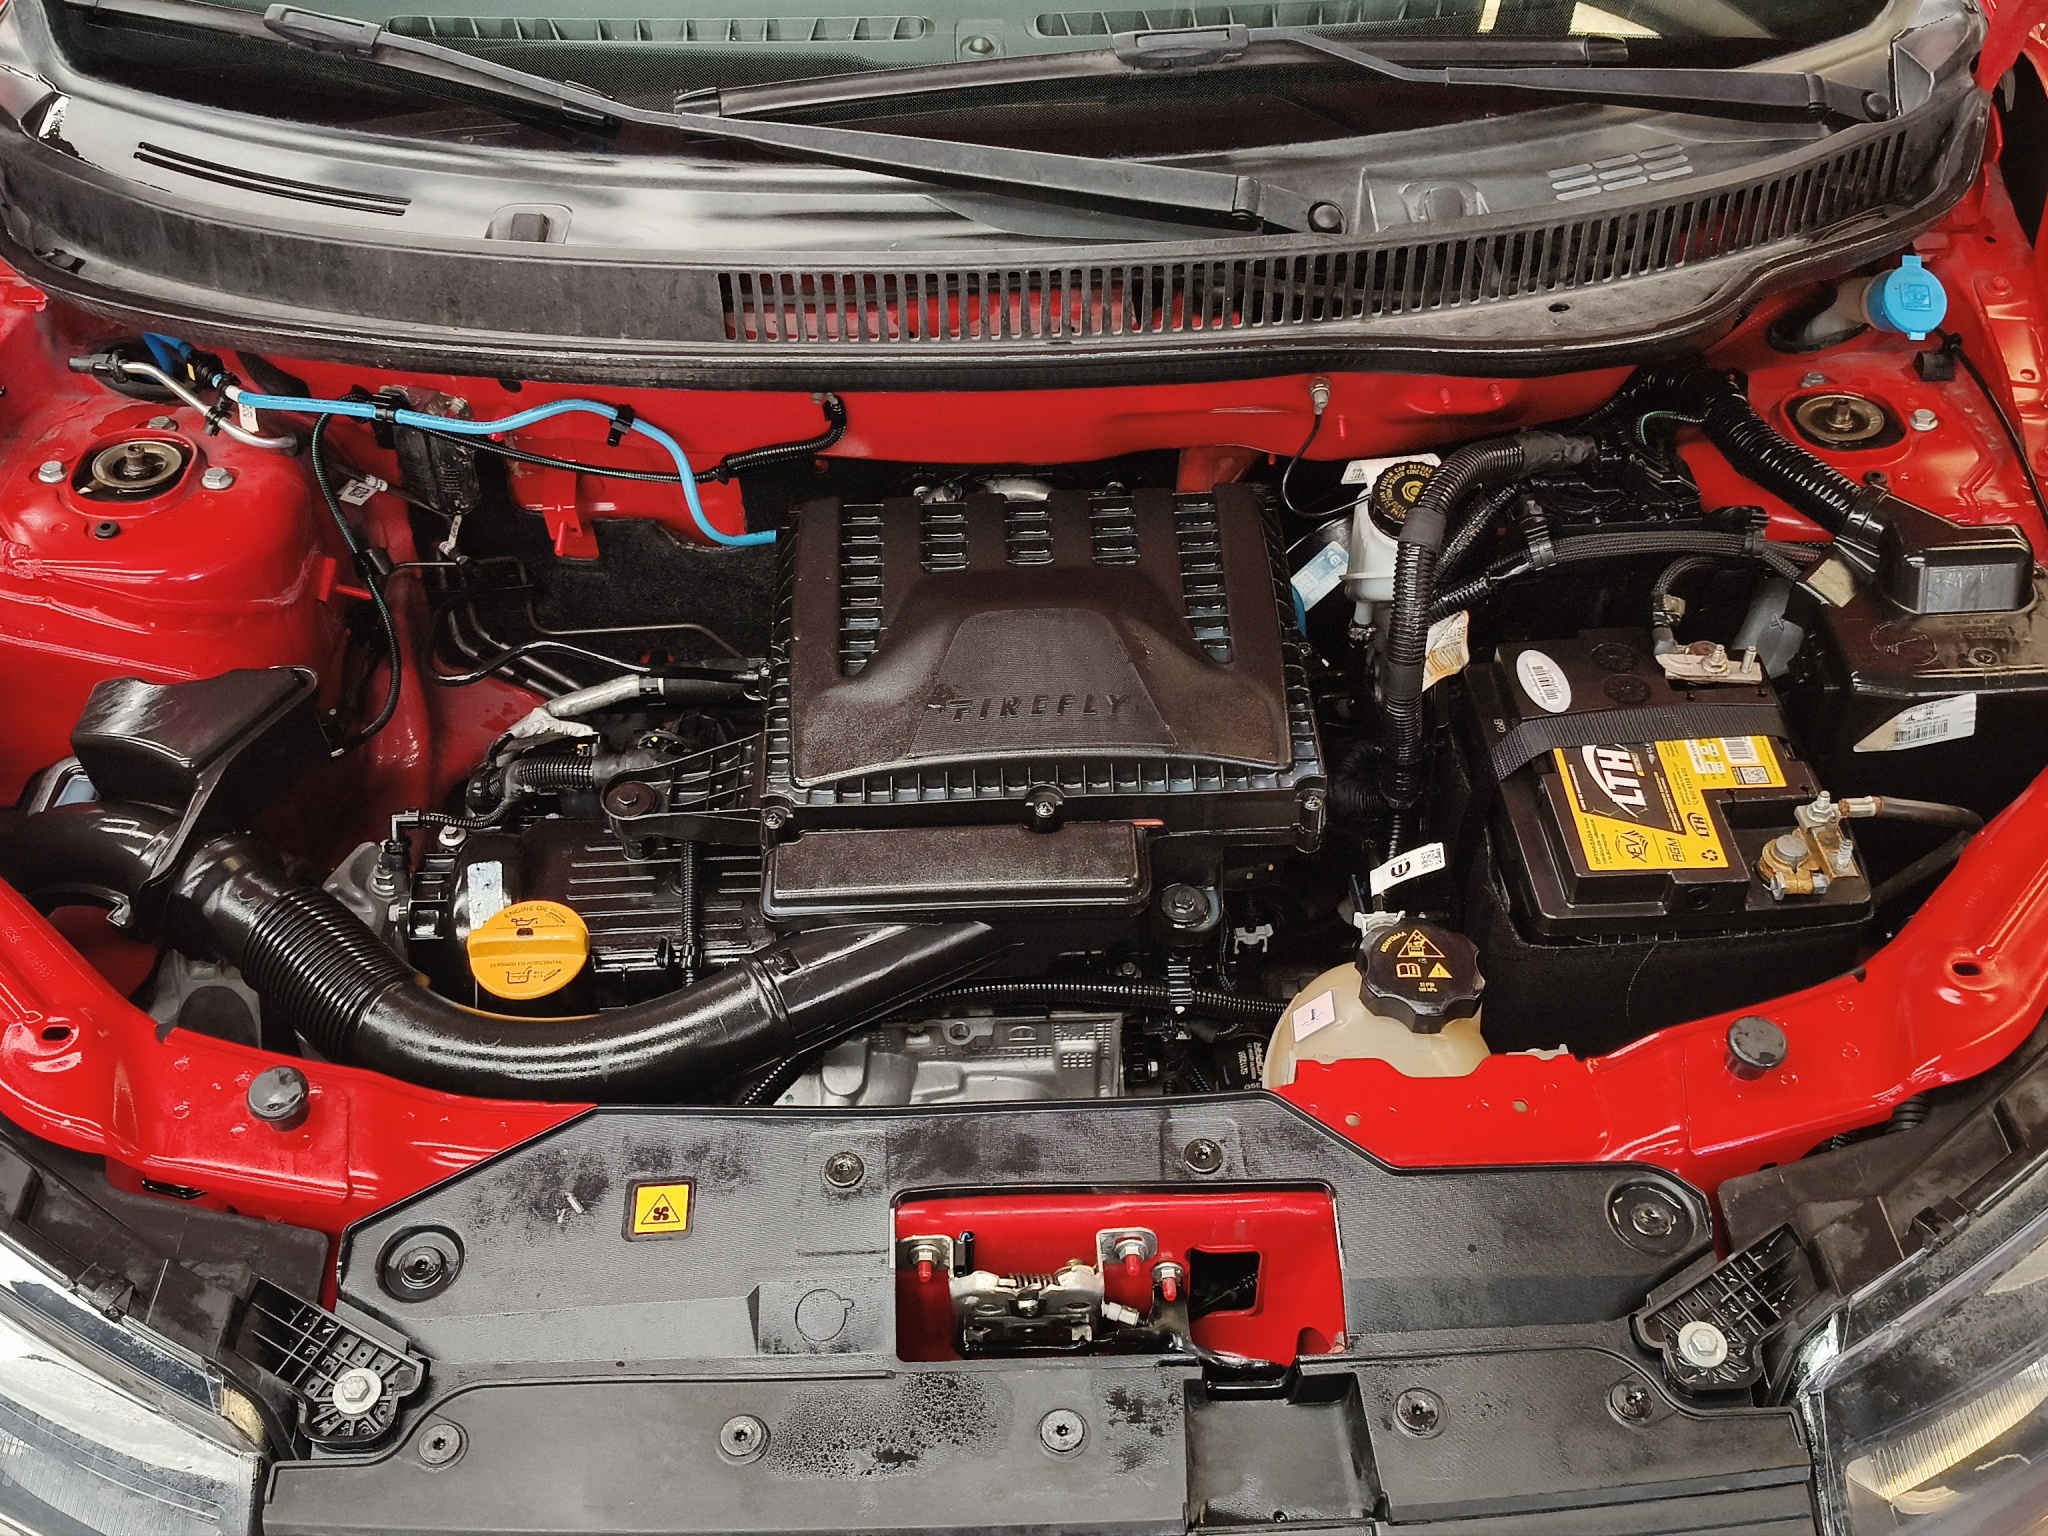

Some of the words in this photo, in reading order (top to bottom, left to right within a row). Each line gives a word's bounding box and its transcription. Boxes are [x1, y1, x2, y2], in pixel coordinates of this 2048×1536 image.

[949, 694, 1130, 722] FIREFLY
[1596, 746, 1647, 807] LTH
[1691, 815, 1710, 837] LTH
[1665, 837, 1683, 862] AGM
[503, 906, 534, 919] ENGINE
[536, 905, 549, 913] OIL
